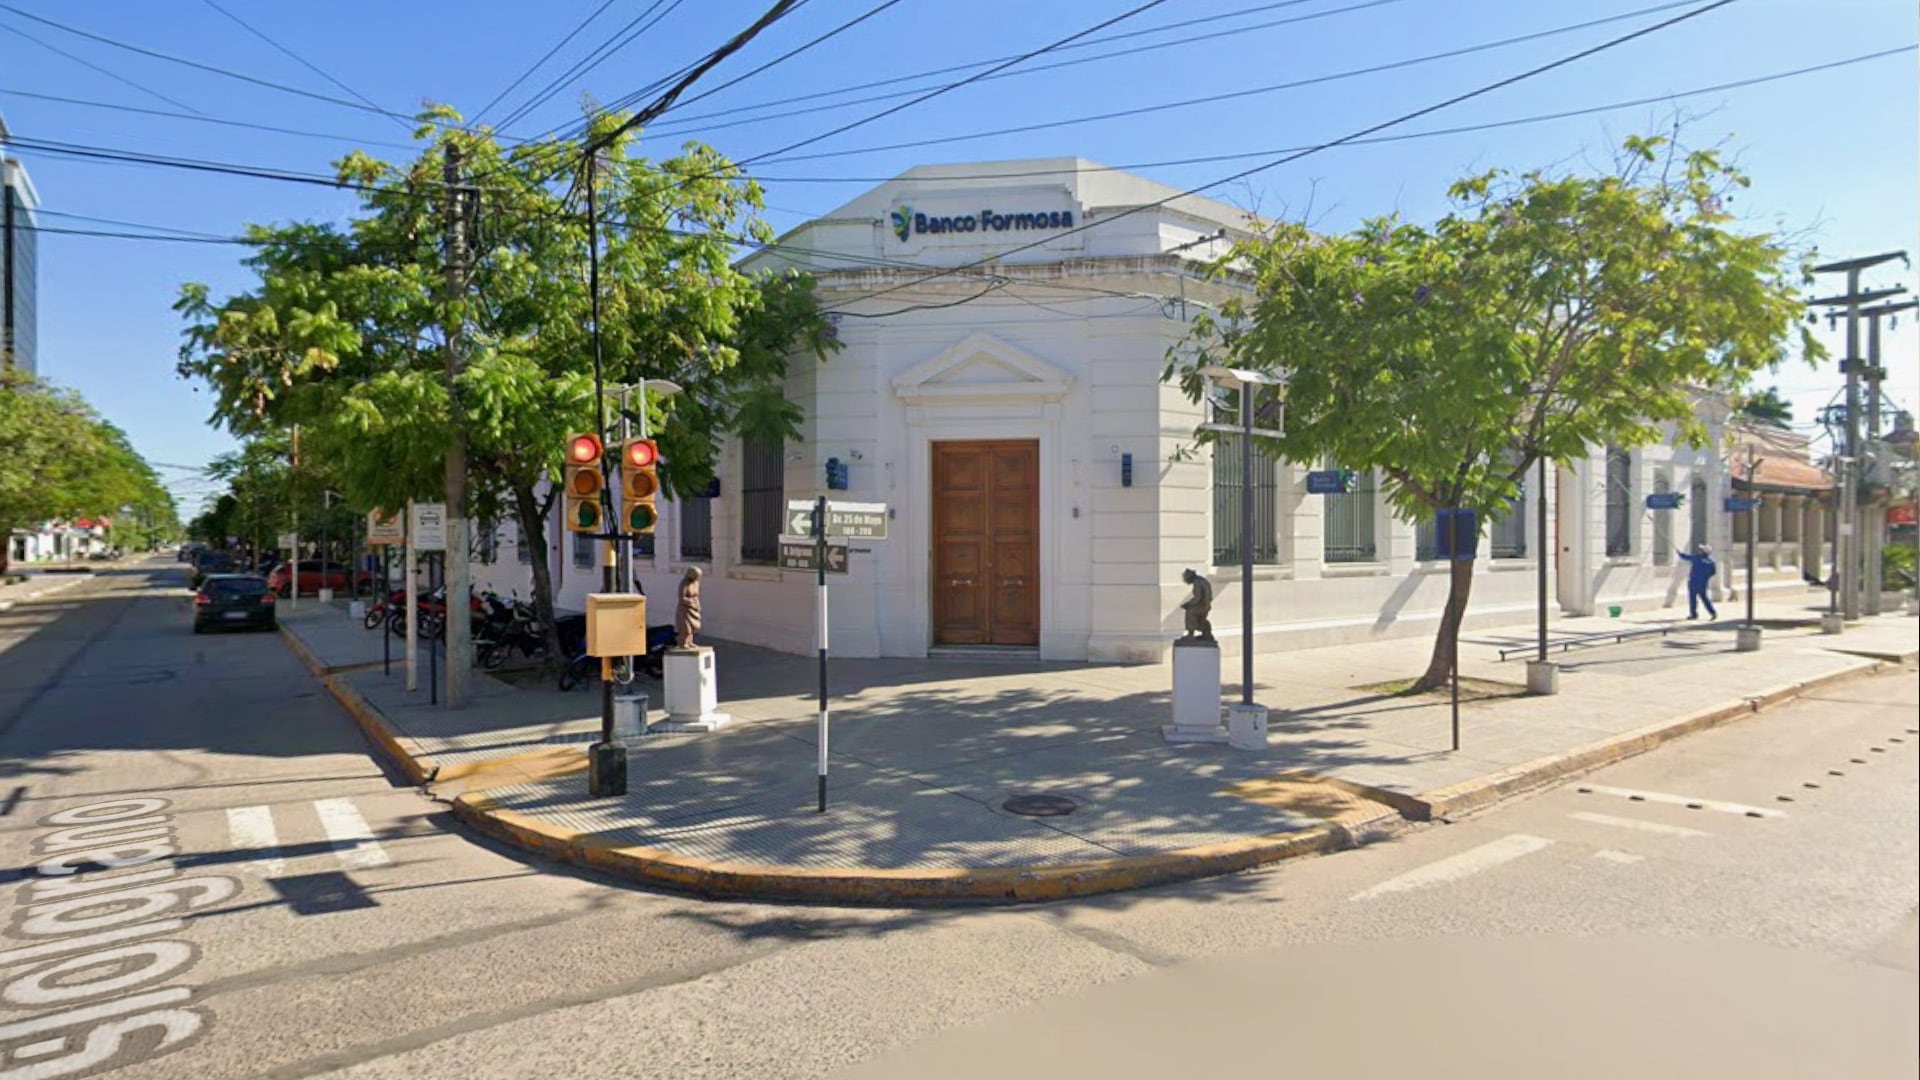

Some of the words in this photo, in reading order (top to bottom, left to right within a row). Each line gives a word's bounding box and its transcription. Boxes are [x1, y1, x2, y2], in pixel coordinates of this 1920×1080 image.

[914, 213, 976, 234] Banco
[981, 210, 1073, 231] Formosa
[843, 514, 853, 525] 25
[854, 514, 862, 525] de
[864, 515, 882, 527] Mayo
